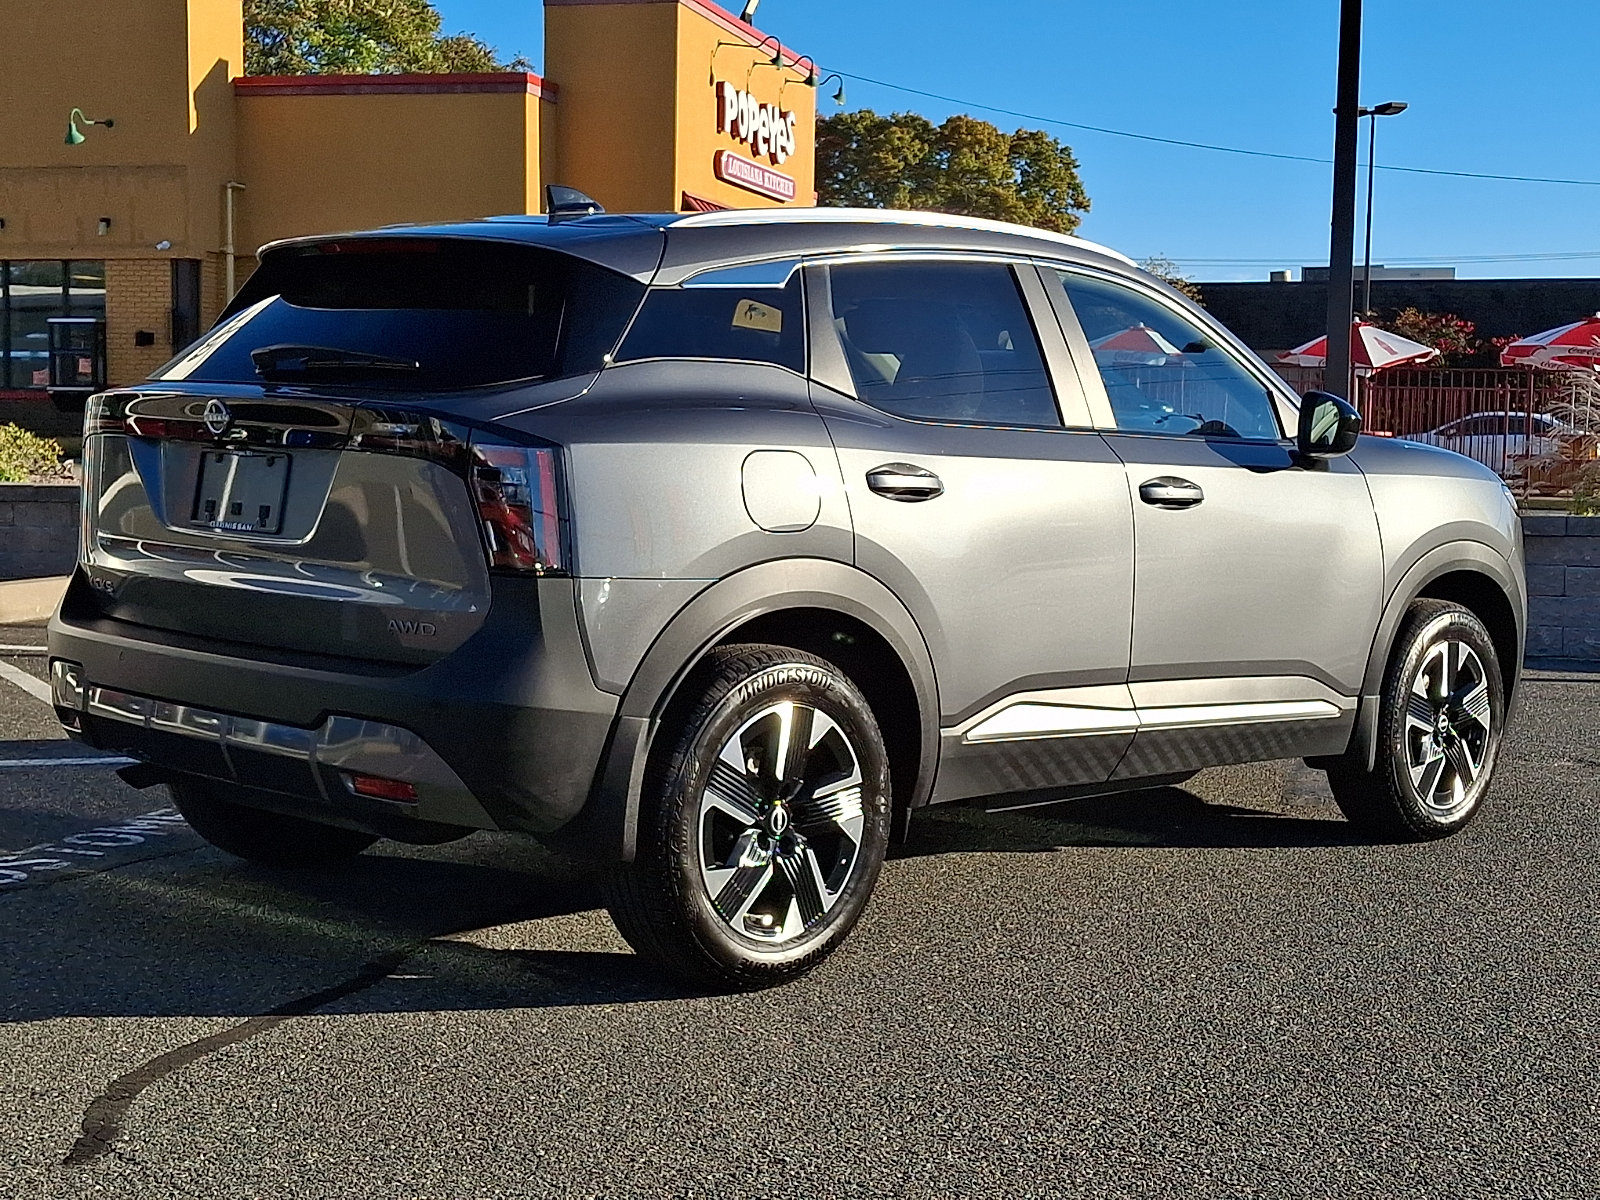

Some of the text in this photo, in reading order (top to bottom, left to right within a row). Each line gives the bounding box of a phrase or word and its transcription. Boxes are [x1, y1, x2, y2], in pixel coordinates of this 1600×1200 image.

[727, 156, 794, 197] LOUISIANA KITCHEN
[387, 619, 437, 636] AWD
